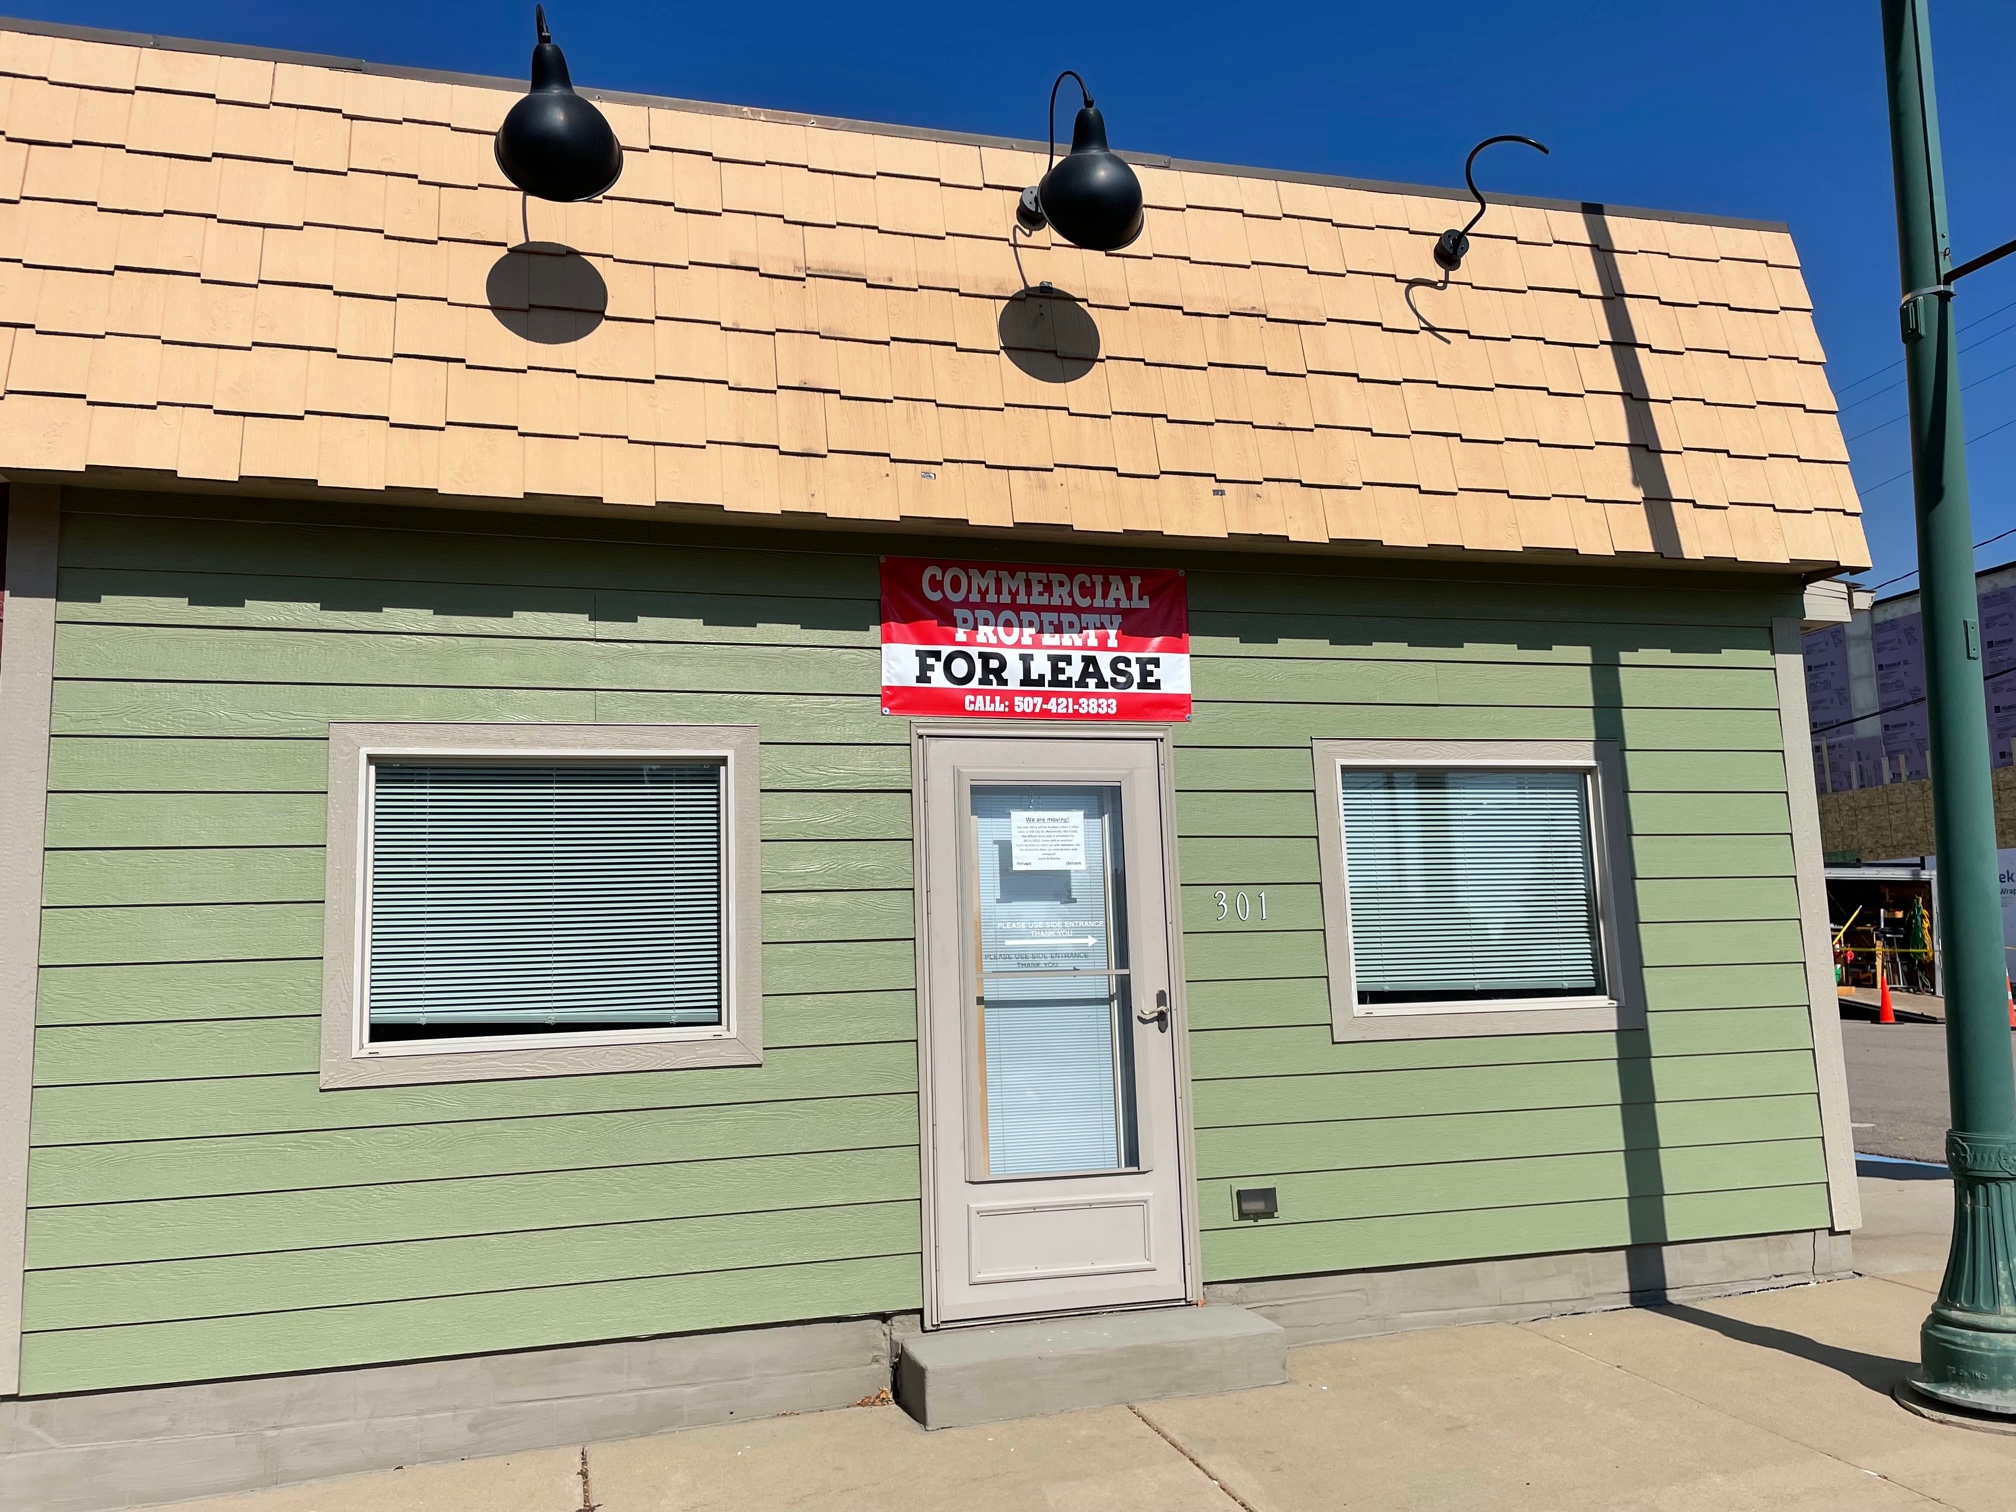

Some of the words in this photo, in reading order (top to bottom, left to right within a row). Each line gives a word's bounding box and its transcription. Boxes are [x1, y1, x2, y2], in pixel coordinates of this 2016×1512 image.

[921, 565, 1150, 609] COMMERCIAL
[952, 608, 1122, 648] PROPERTY
[915, 649, 1008, 687] FOR
[1018, 653, 1161, 690] LEASE
[964, 694, 1009, 713] CALL:
[1013, 695, 1117, 715] 507-421-3833
[1999, 870, 2015, 883] ek
[1213, 890, 1267, 921] 301
[997, 921, 1026, 929] PLEASE
